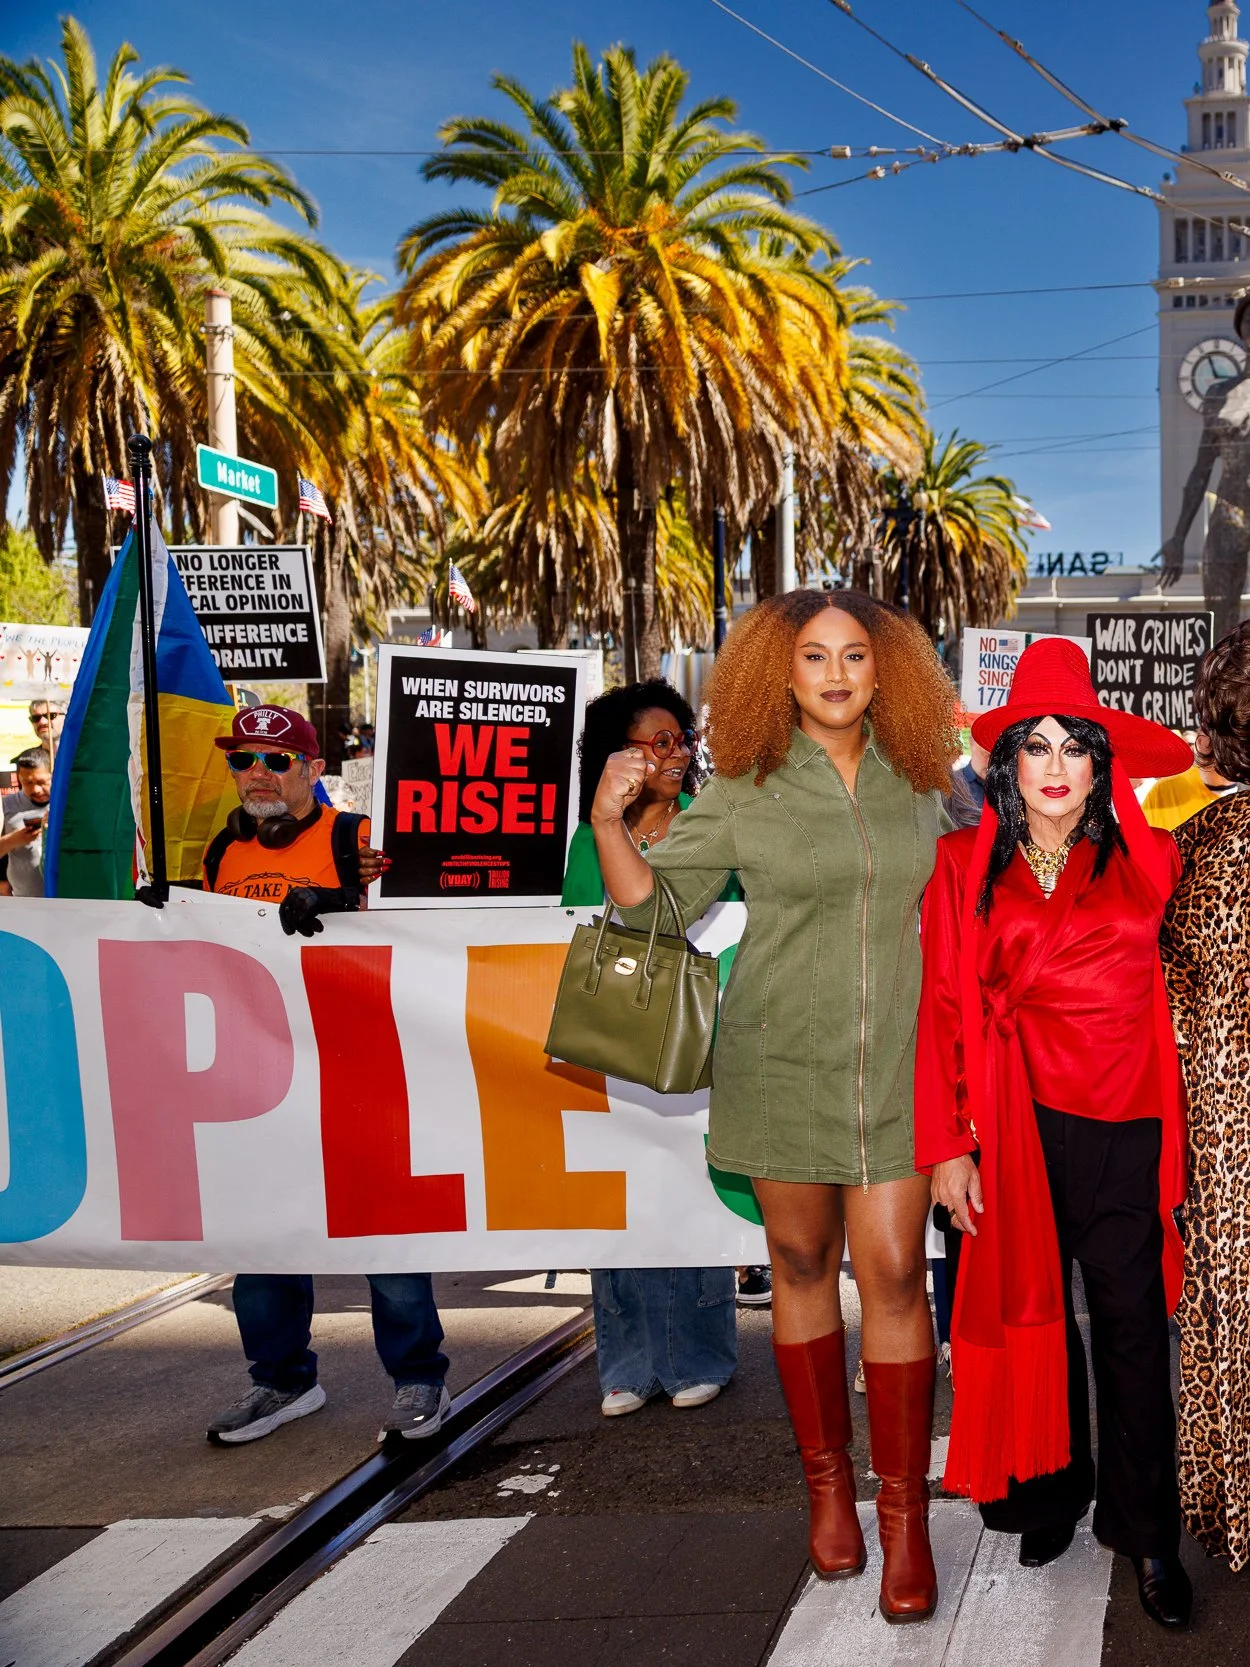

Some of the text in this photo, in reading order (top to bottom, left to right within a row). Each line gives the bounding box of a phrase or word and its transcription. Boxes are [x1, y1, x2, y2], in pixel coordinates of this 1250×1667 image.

[217, 460, 261, 495] Market
[176, 553, 281, 572] NO LONGER
[271, 573, 292, 591] IN
[225, 593, 304, 611] OPINION
[979, 636, 998, 653] NO
[1095, 617, 1207, 657] WAR CRIMES
[979, 653, 1018, 671] KINGS
[1096, 658, 1195, 686] DON'T HIDE
[401, 676, 566, 704] WHEN SURVIVORS
[977, 686, 1011, 707] 177
[253, 709, 279, 720] PHILLY
[415, 700, 551, 727] ARE SILENCED,
[1141, 689, 1200, 728] CRIME
[433, 723, 531, 778] WE
[395, 779, 558, 834] RISE!
[244, 882, 283, 899] TAKE
